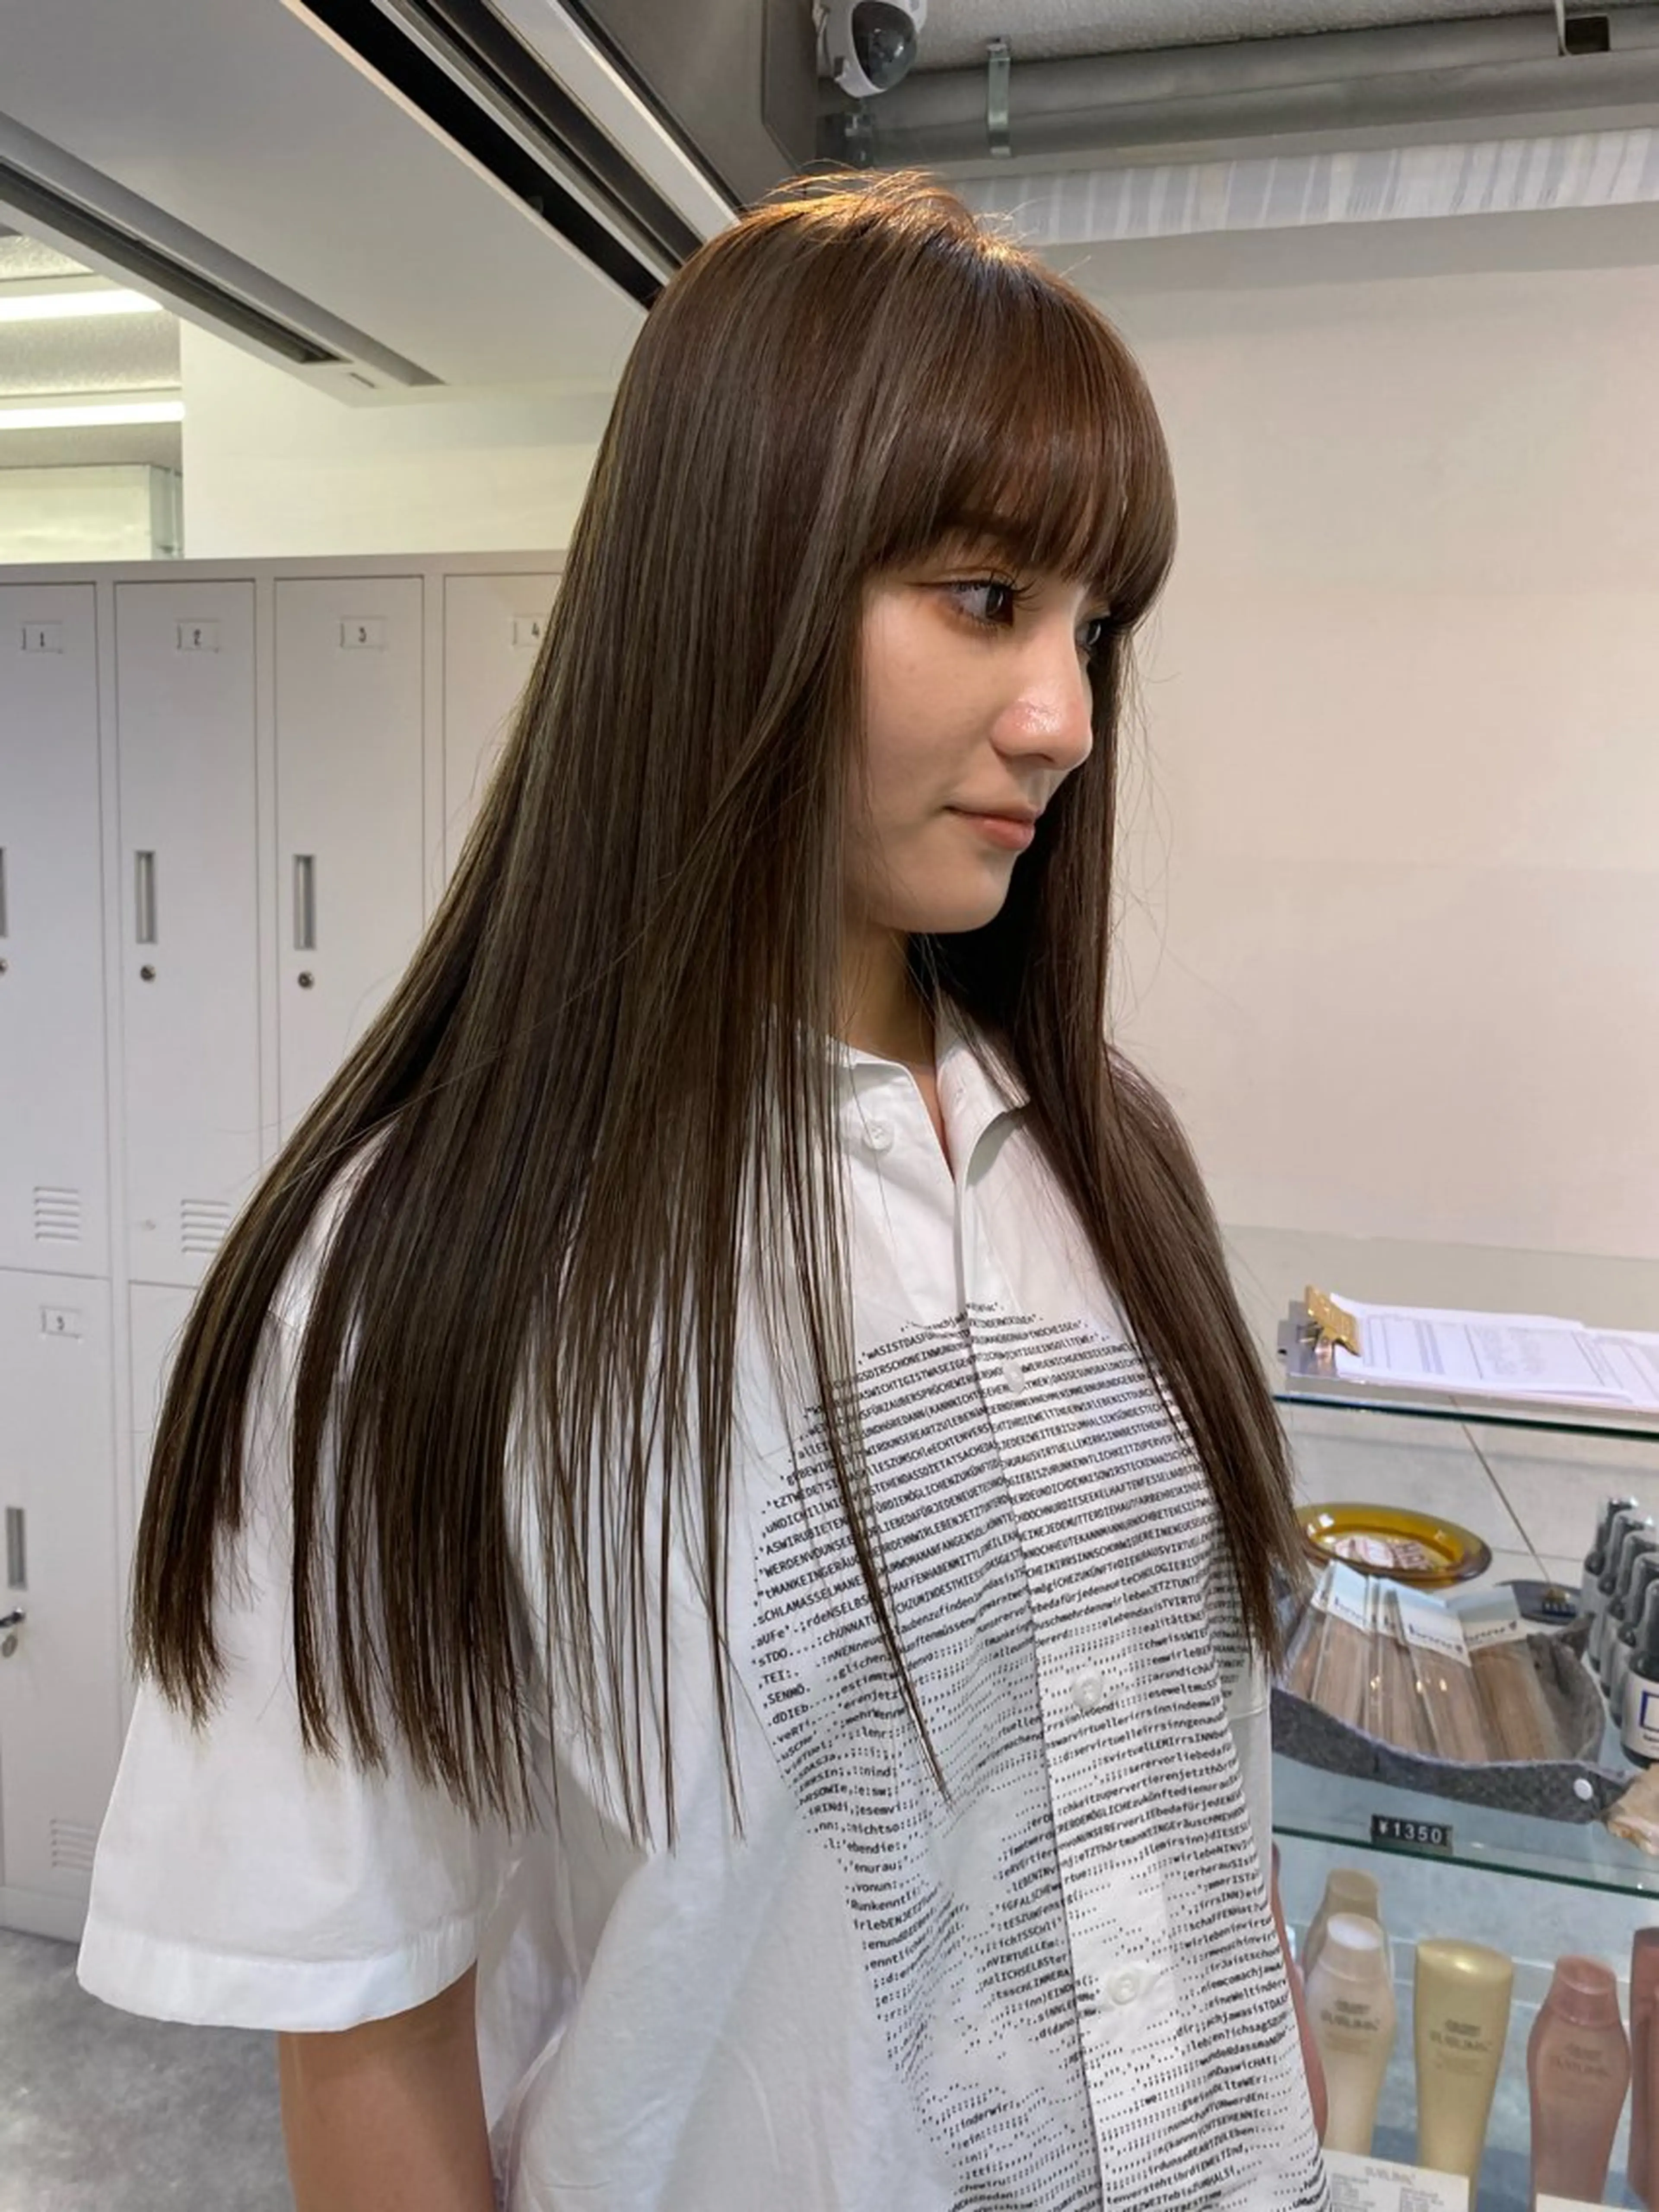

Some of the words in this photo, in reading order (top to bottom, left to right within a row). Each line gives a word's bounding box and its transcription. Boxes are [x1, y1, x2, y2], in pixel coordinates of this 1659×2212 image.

[193, 629, 201, 646] 2
[358, 626, 367, 643] 3
[1379, 1820, 1443, 1844] ¥1350
